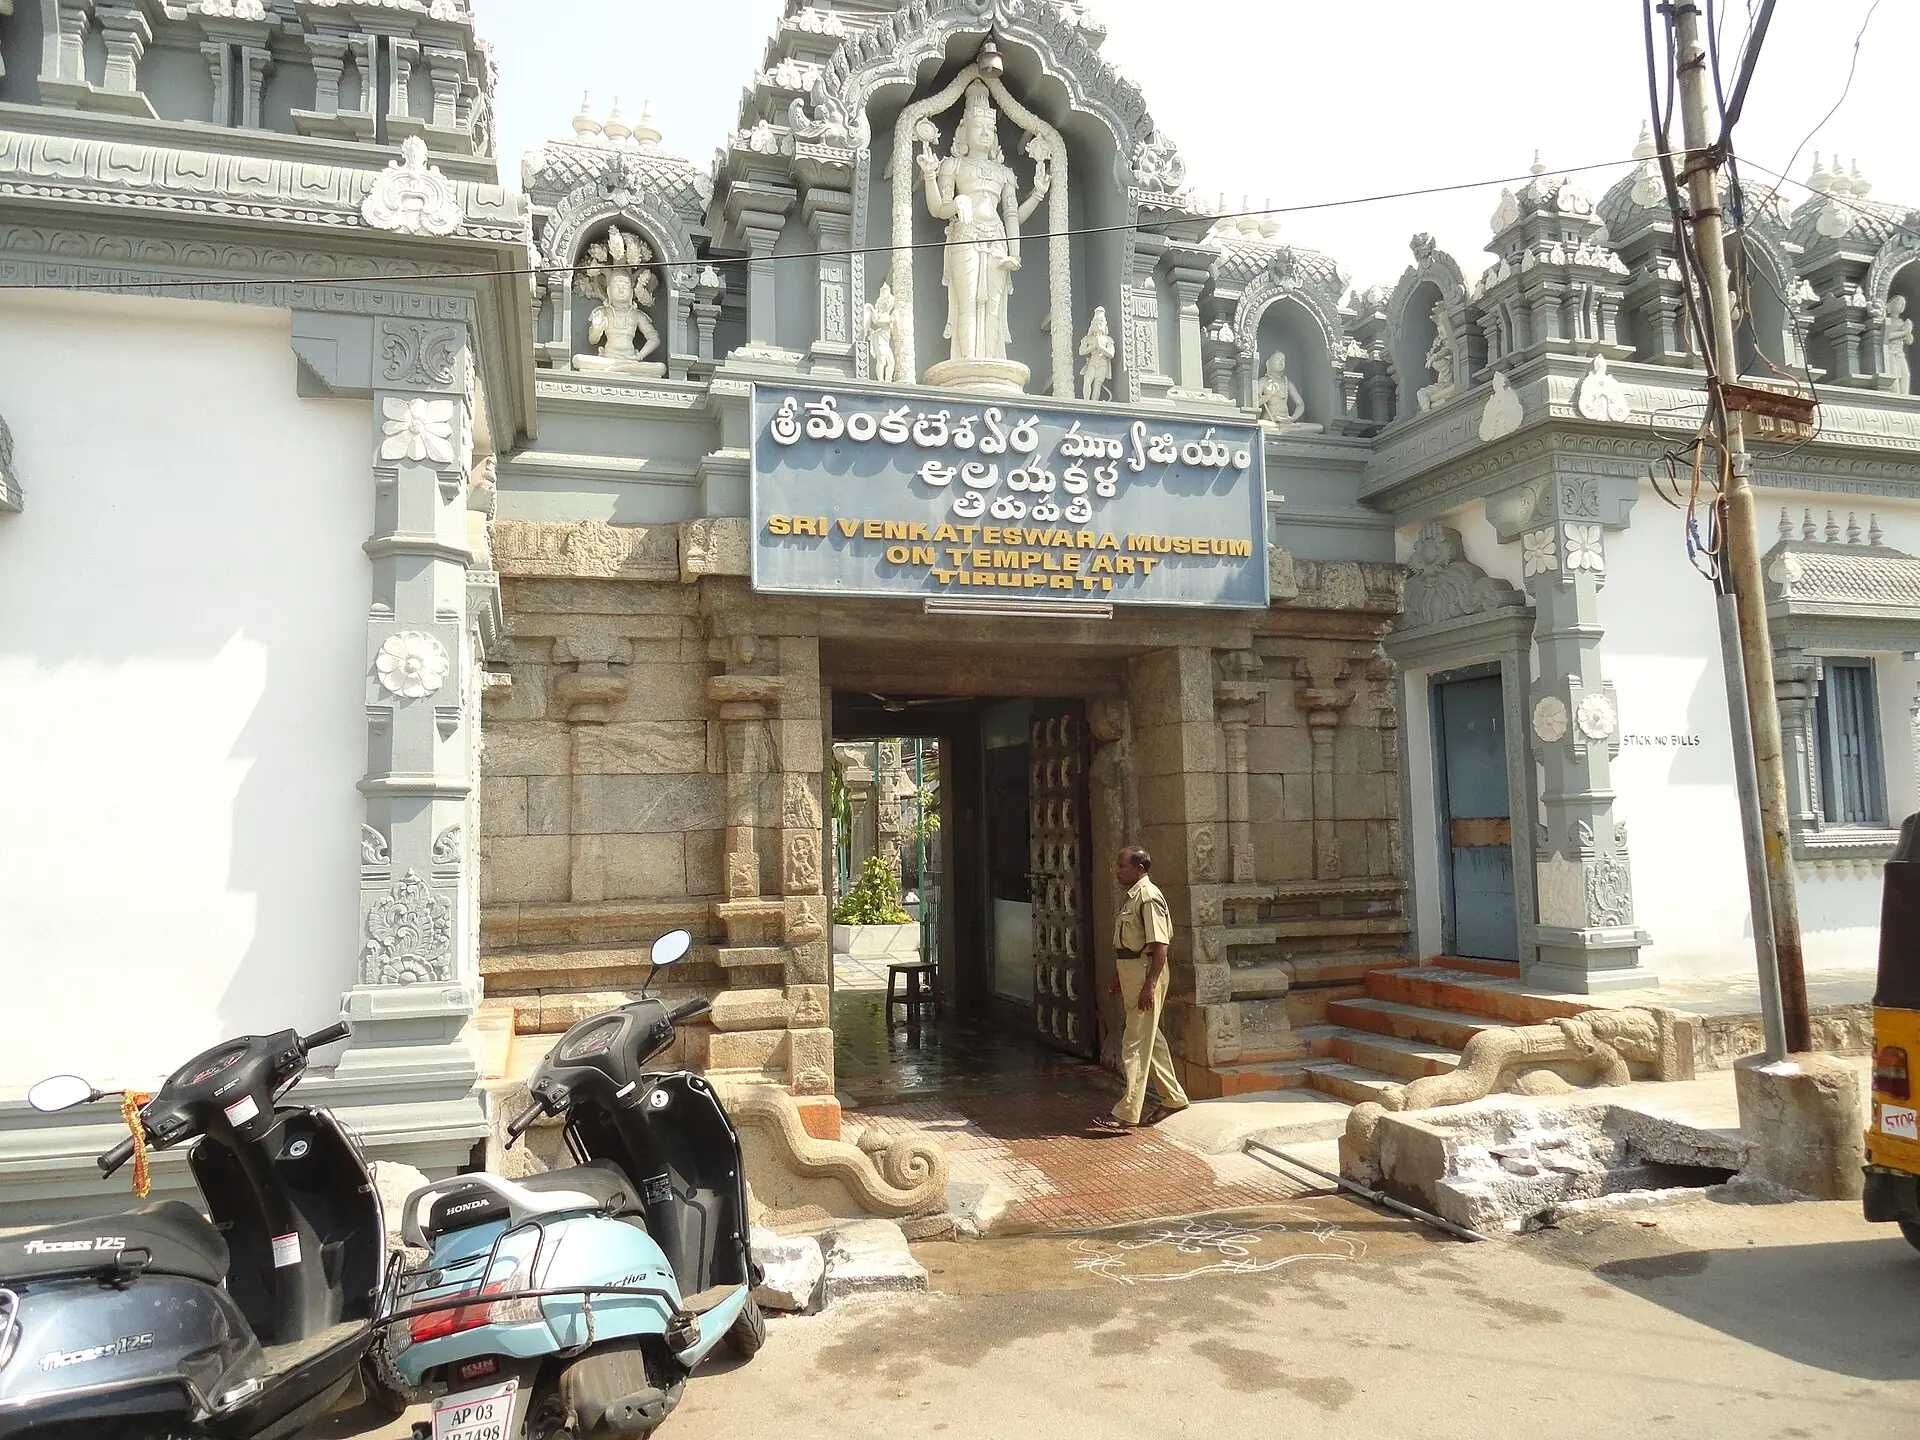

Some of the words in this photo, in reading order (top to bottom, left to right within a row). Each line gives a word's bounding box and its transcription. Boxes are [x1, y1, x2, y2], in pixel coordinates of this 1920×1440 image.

[952, 491, 1093, 523] తిరుపతి
[768, 514, 828, 536] SRI
[836, 518, 1120, 550] VENKATESWARA
[1127, 533, 1252, 557] MUSEUM
[886, 545, 935, 565] ON
[945, 548, 1081, 571] TEMPLE
[1091, 555, 1158, 575] ART
[931, 569, 1113, 591] TIRUPATI
[1623, 735, 1651, 746] STICK
[1655, 735, 1668, 746] NO
[1671, 735, 1700, 746] BILLS
[446, 1198, 490, 1216] HONDA
[24, 1240, 92, 1254] Access
[94, 1237, 126, 1250] 125
[38, 1343, 116, 1372] Access
[118, 1333, 154, 1355] 125
[451, 1408, 471, 1426] AP
[475, 1404, 493, 1421] 03
